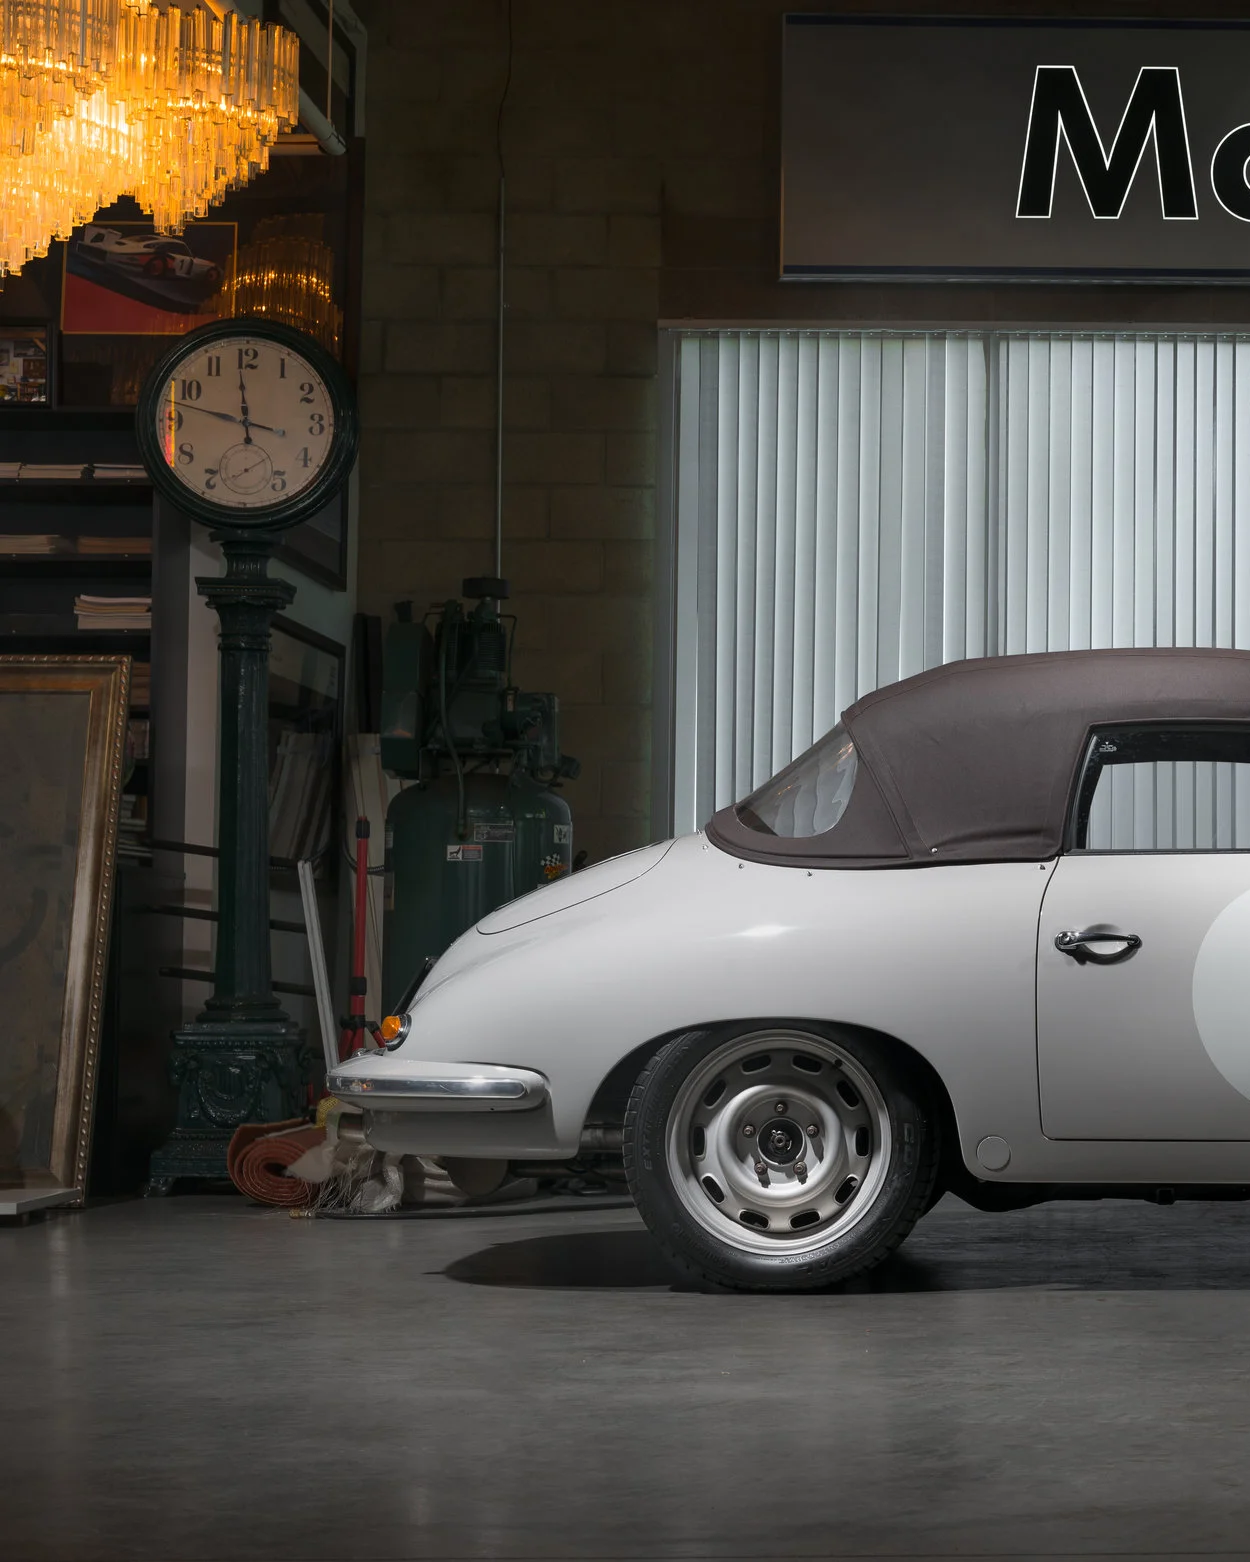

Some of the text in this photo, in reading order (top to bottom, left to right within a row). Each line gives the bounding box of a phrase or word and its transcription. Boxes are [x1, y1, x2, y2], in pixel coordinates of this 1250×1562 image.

[207, 356, 221, 377] 11
[237, 348, 259, 370] 12
[279, 358, 287, 379] 1
[181, 379, 202, 401] 10
[299, 382, 315, 404] 2
[308, 413, 325, 436] 3
[177, 442, 194, 465] 8
[296, 447, 312, 468] 4
[204, 468, 219, 490] 7
[271, 470, 287, 492] 5
